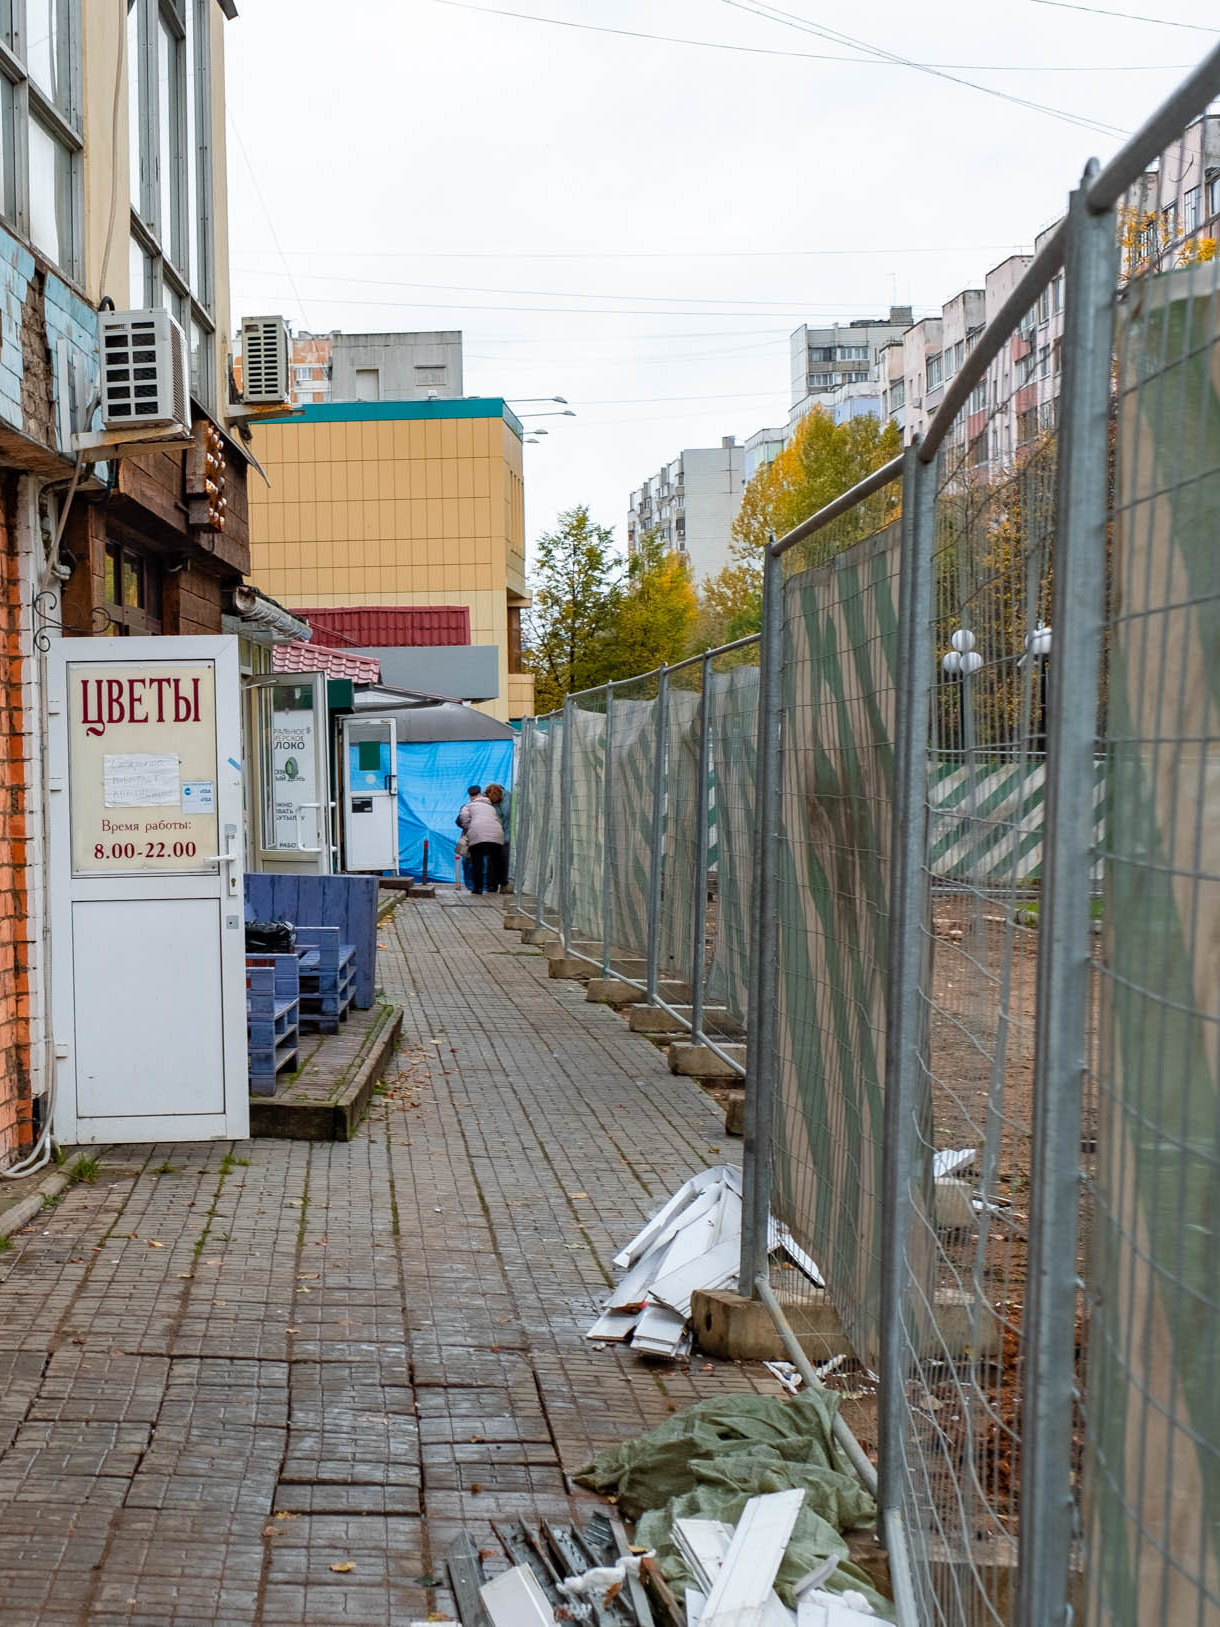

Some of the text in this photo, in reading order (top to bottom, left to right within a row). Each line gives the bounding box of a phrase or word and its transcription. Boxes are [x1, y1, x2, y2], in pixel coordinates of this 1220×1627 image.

[80, 677, 201, 737] ЦВЕТЫ
[274, 741, 305, 750] ЛОКО
[101, 819, 192, 835] Время работы:
[94, 841, 197, 860] 8.00-22.00
